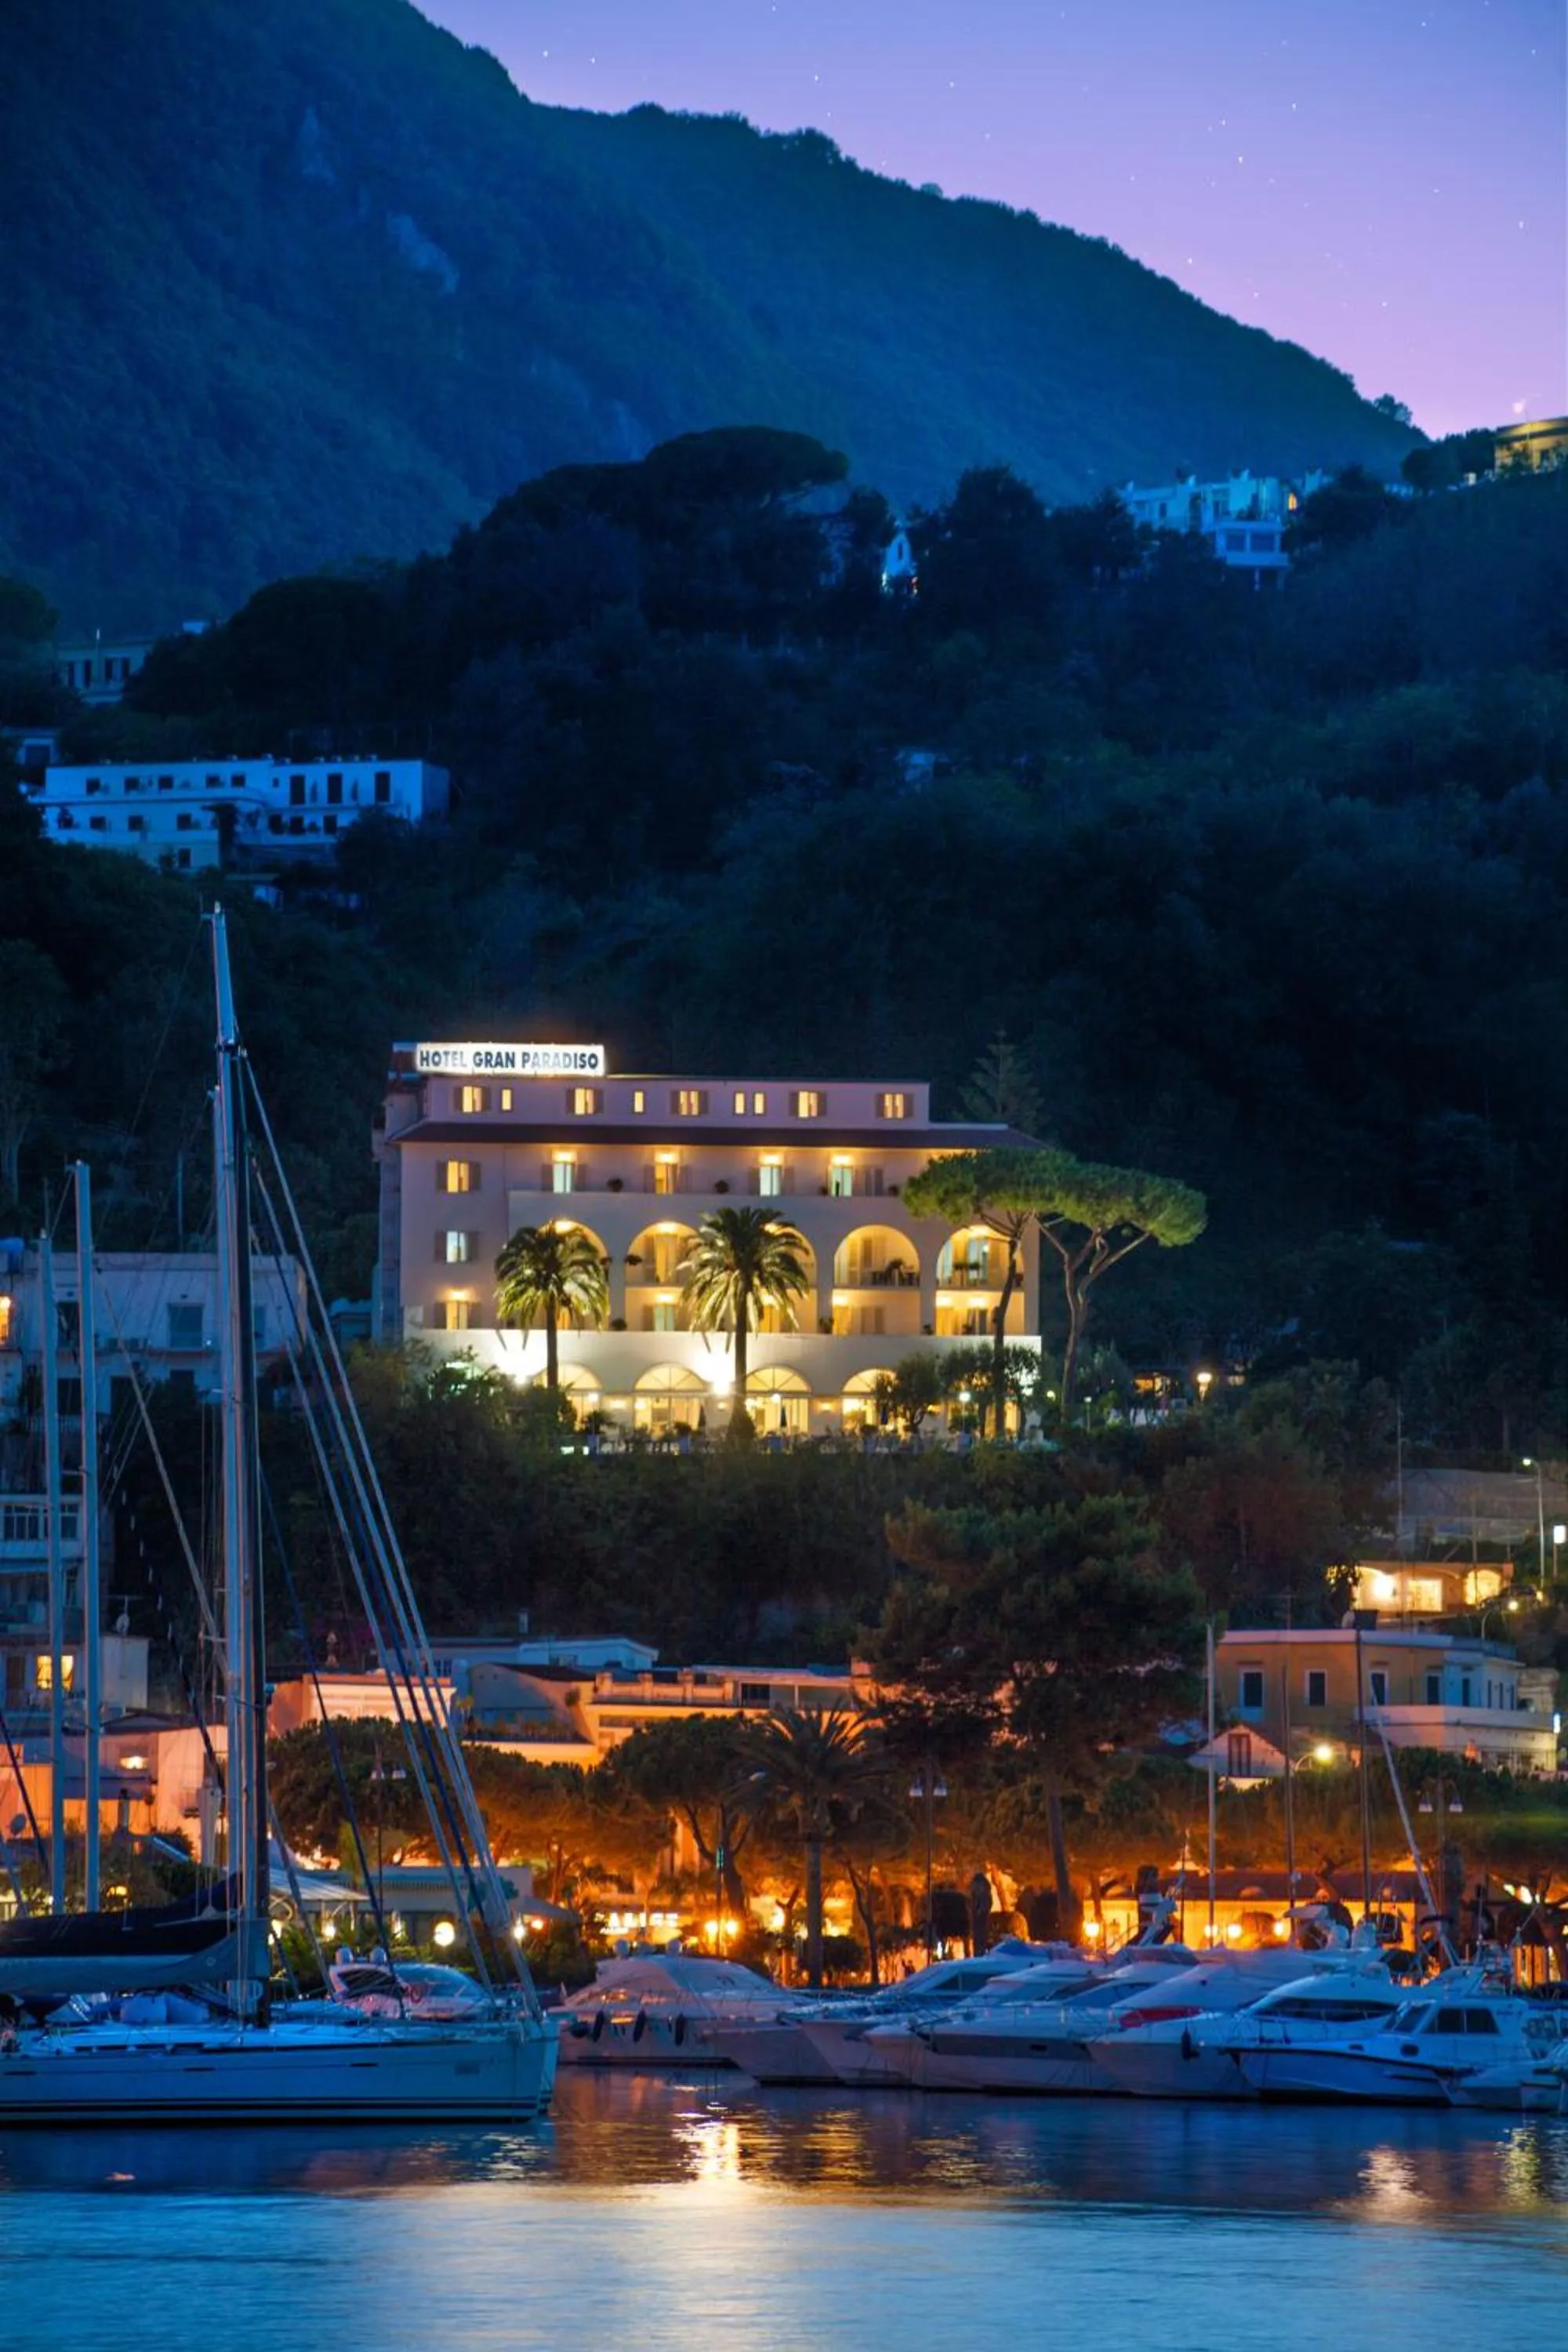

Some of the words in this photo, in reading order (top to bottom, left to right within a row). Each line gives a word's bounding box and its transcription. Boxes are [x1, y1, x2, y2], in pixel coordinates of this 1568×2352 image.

[419, 1051, 467, 1067] HOTEL
[473, 1051, 515, 1068] GRAN
[521, 1051, 598, 1069] PARADISO
